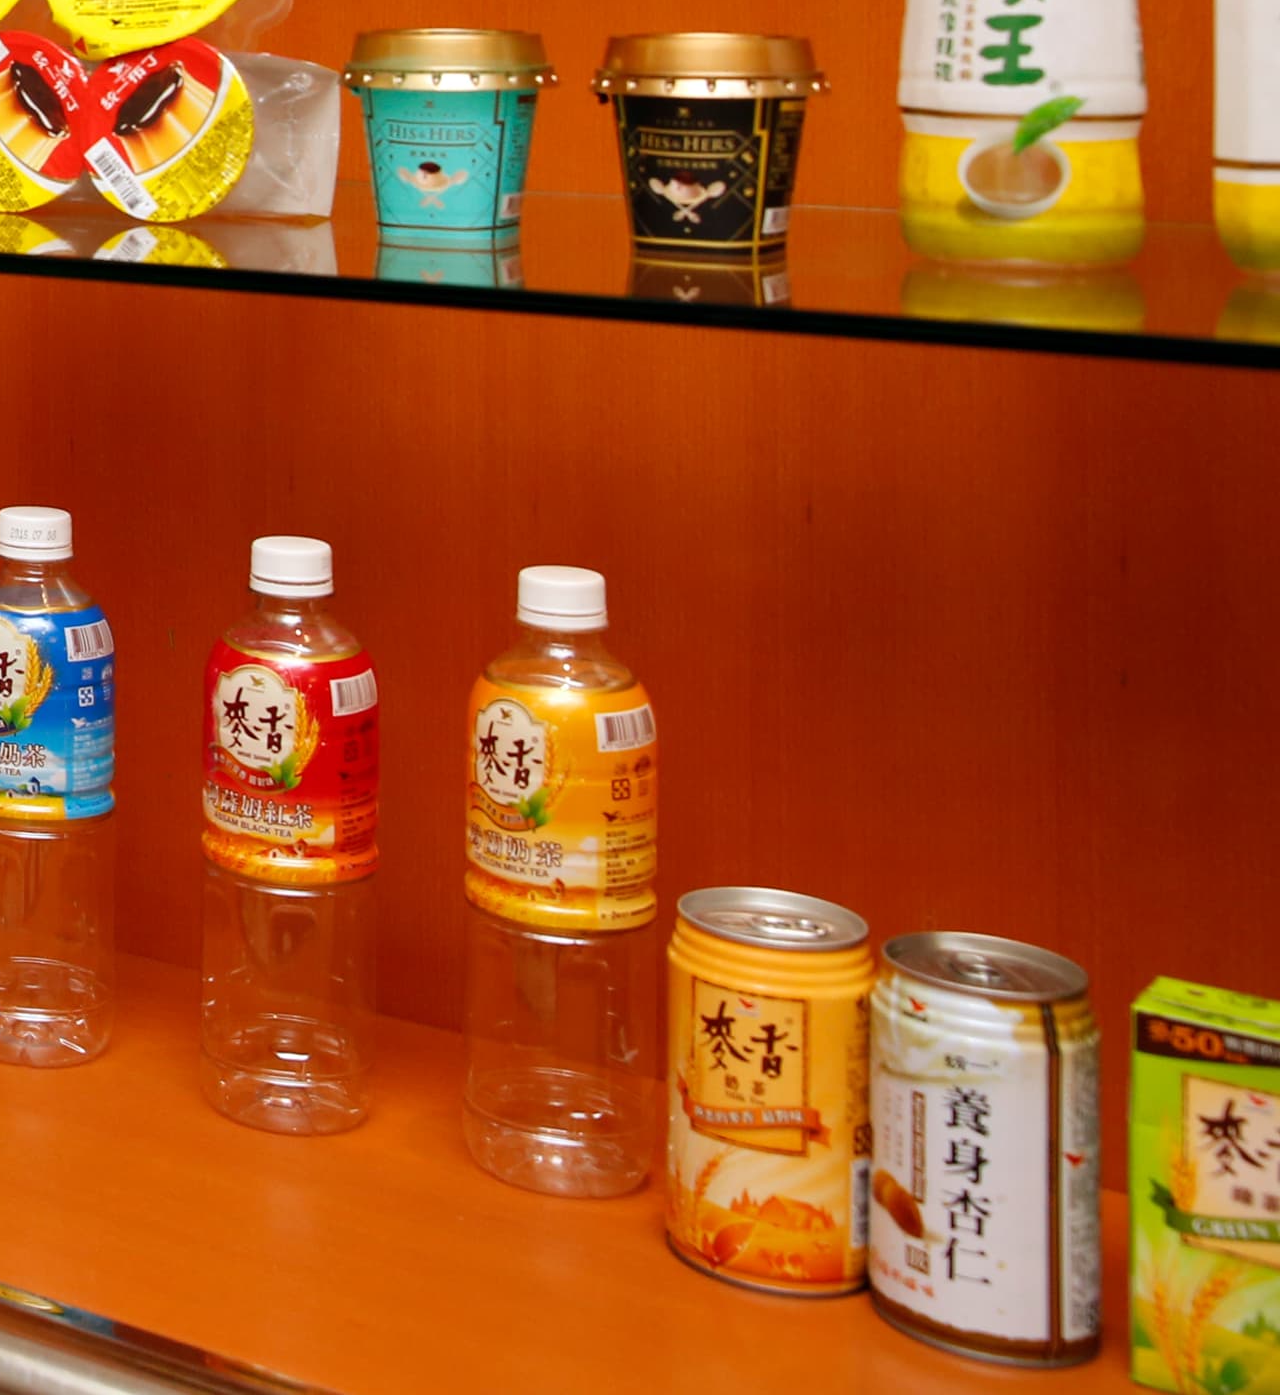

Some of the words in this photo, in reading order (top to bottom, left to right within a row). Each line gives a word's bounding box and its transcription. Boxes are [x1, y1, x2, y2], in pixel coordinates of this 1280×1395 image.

[222, 687, 294, 754] 麥香
[4, 765, 22, 777] TEA
[479, 720, 543, 790] 麥香
[240, 821, 272, 835] BLACK
[274, 826, 293, 839] TEA
[503, 862, 527, 874] MILK
[529, 866, 549, 878] TEA
[698, 1000, 799, 1080] 麥香
[943, 1085, 992, 1288] 養身杏仁
